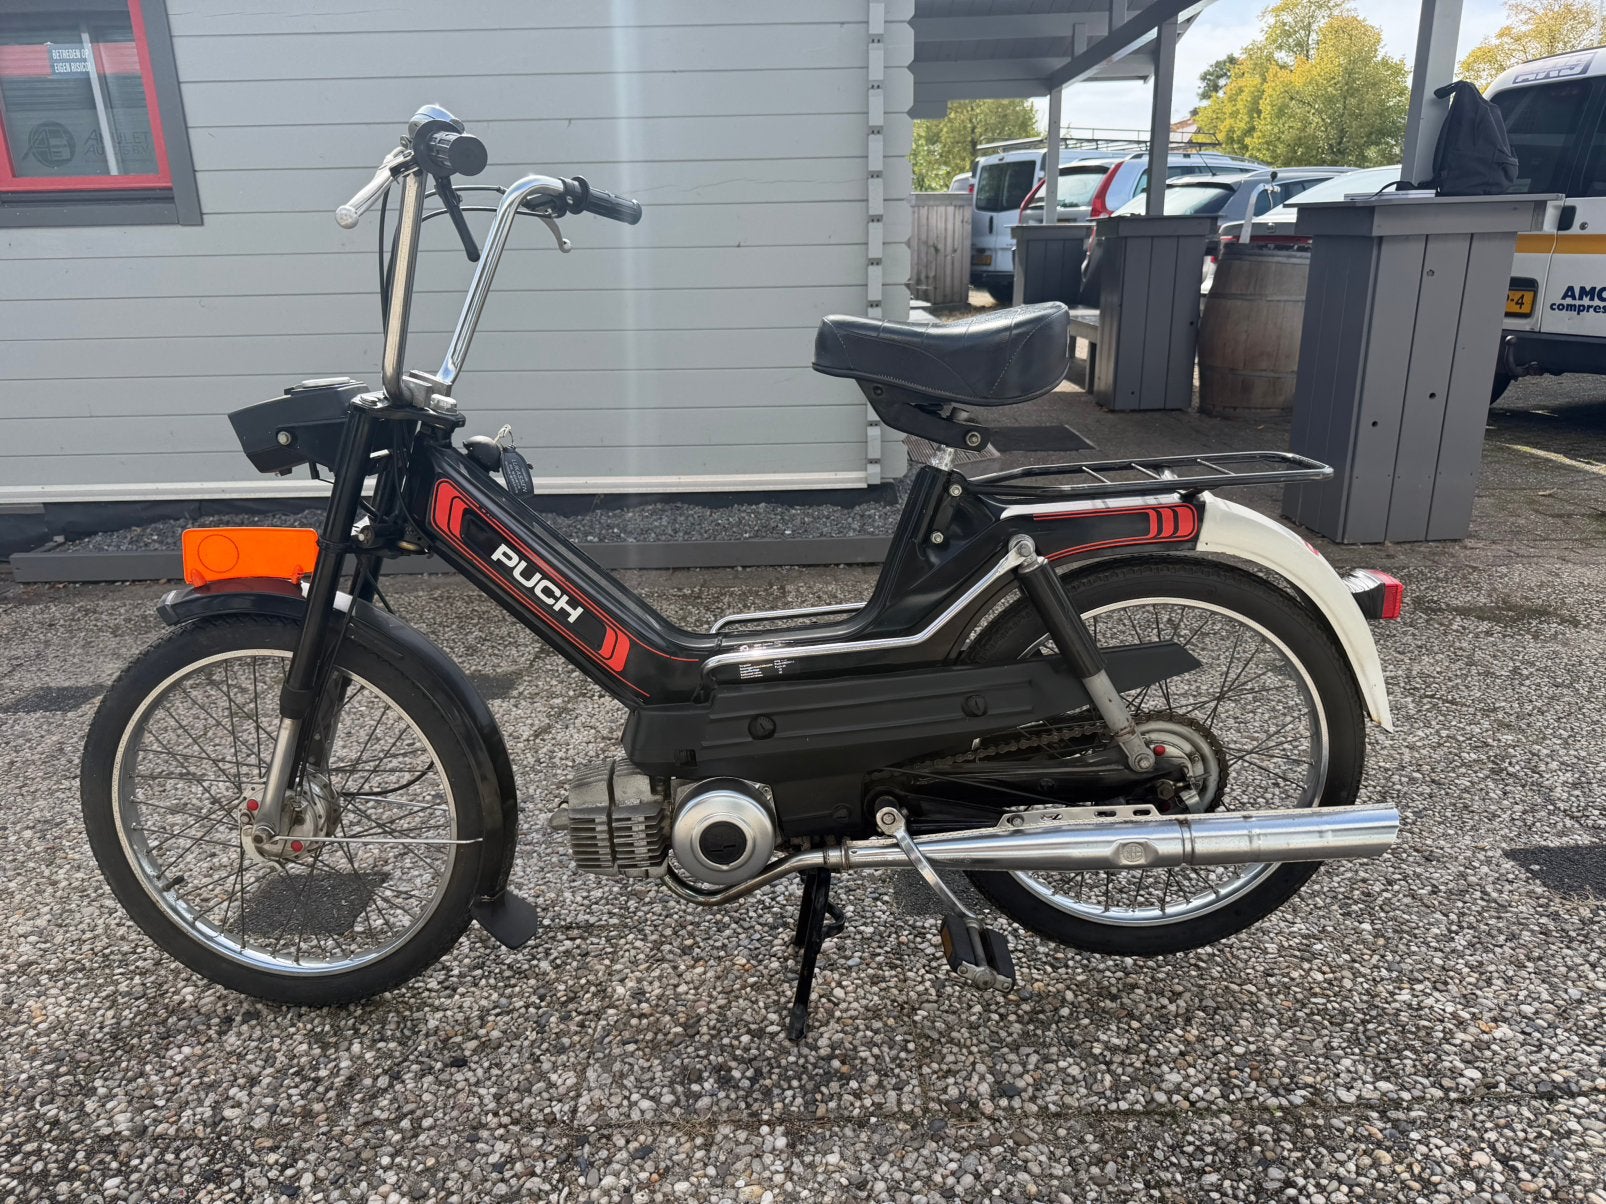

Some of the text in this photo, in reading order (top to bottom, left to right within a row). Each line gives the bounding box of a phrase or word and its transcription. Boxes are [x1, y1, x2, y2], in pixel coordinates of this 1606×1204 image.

[52, 49, 81, 60] BETREDEN
[54, 62, 71, 73] EIGEN
[490, 543, 584, 624] PUCH
